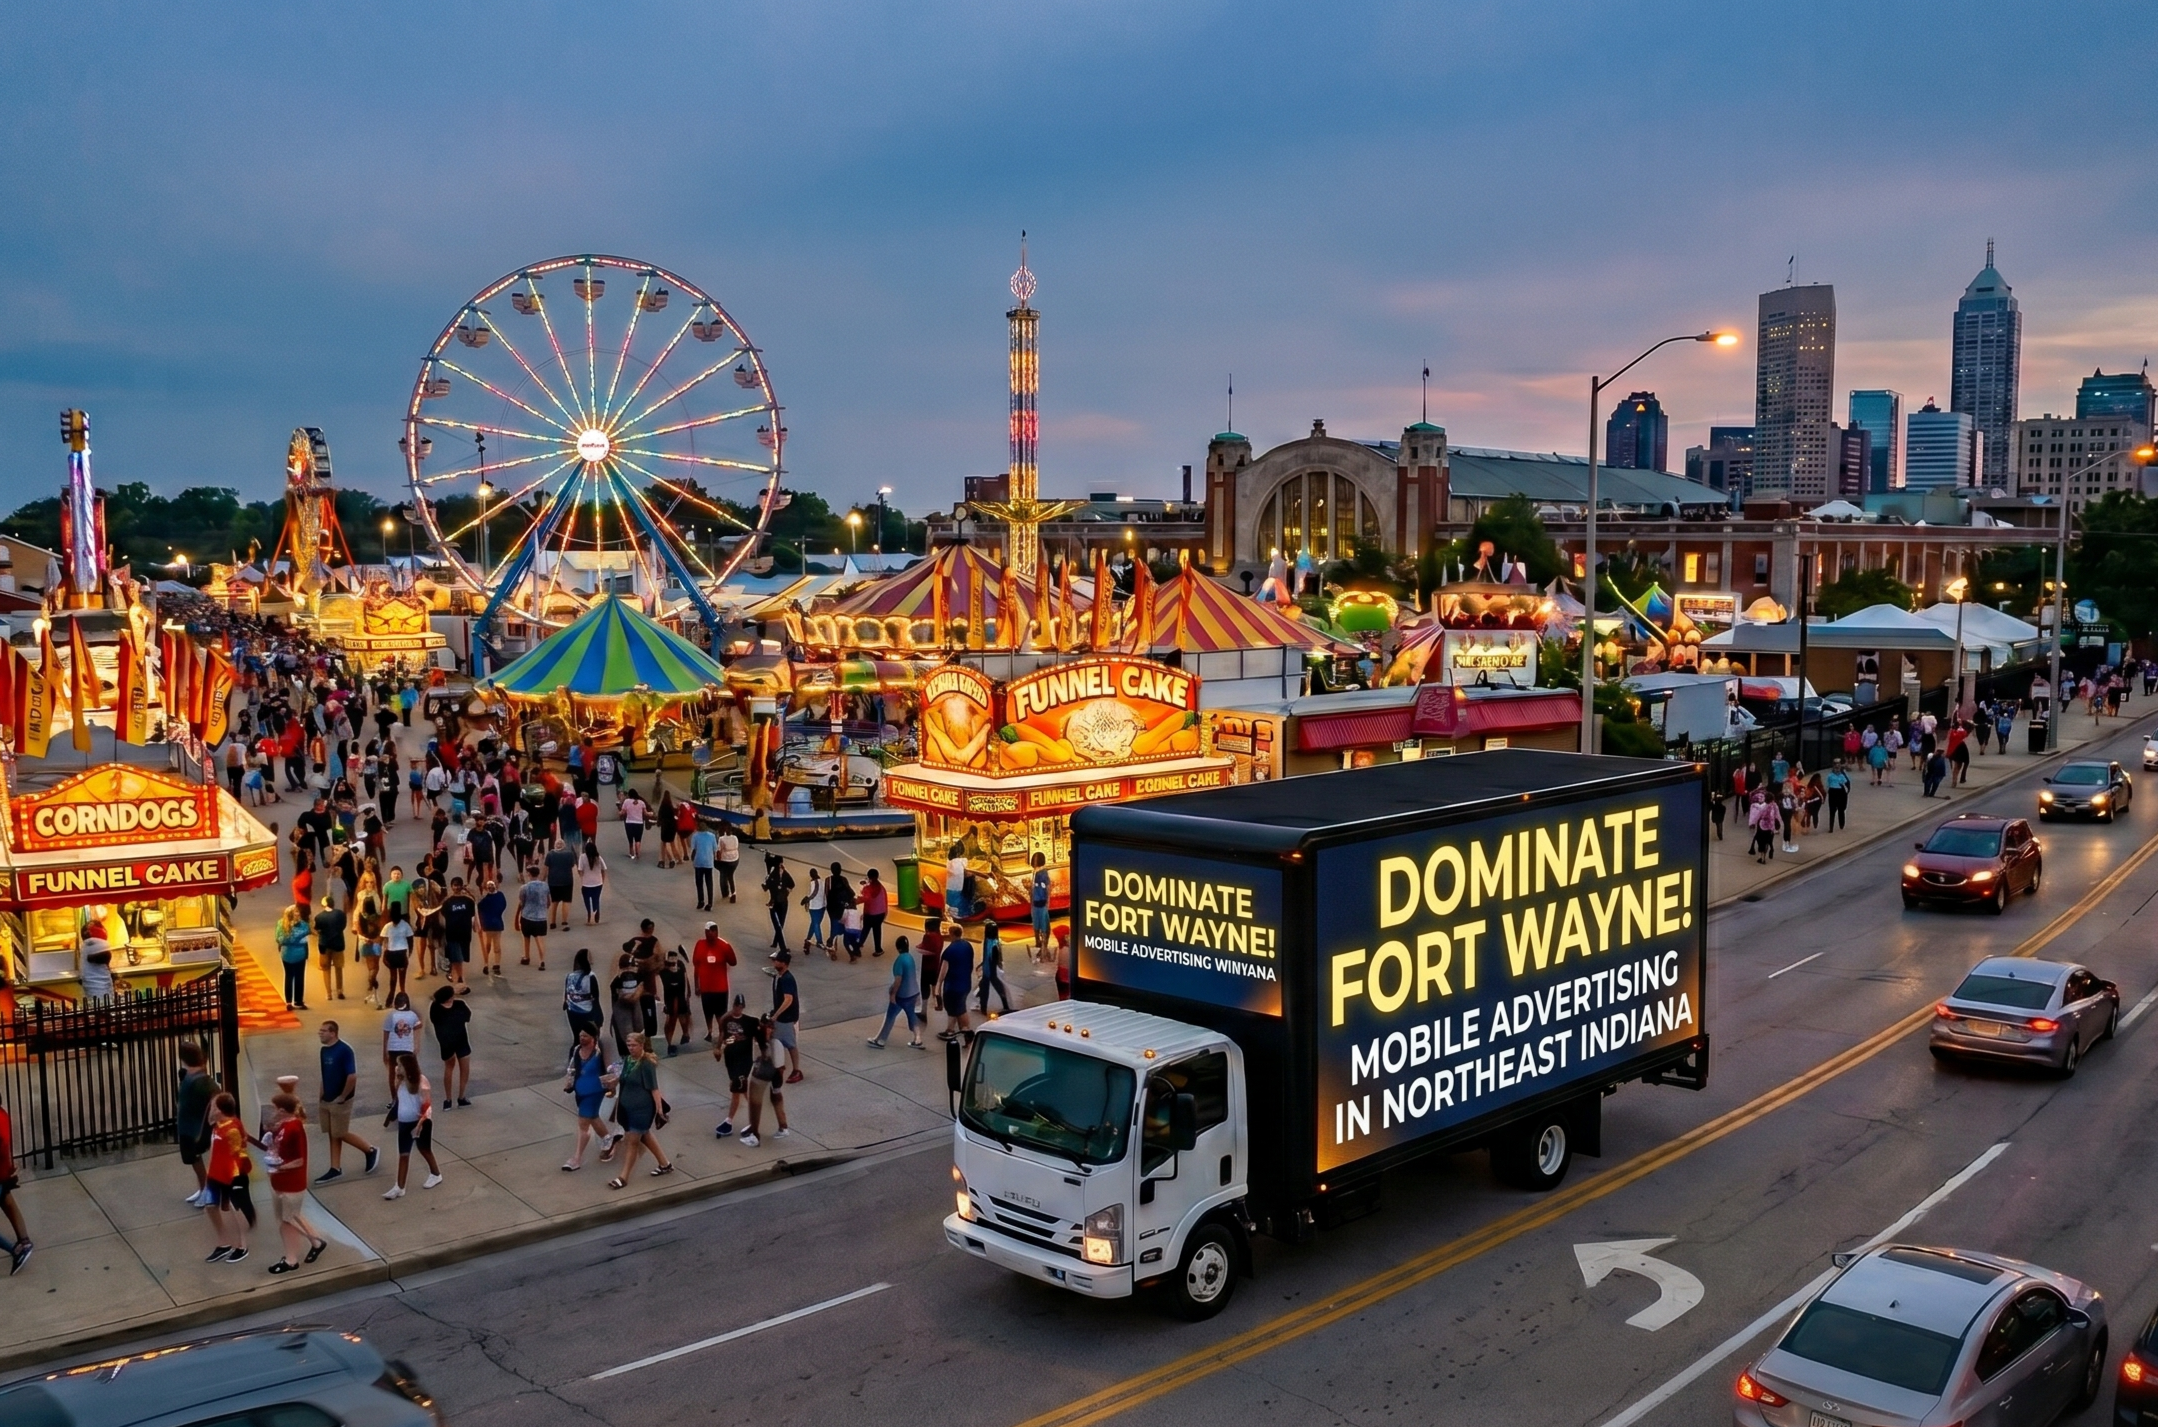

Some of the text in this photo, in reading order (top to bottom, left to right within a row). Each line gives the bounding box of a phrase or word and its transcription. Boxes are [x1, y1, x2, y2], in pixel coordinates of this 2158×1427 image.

[1013, 665, 1116, 721] FUNNEL
[1121, 666, 1189, 708] CAKE
[35, 799, 198, 837] CORNDOGS
[29, 866, 140, 894] FUNNEL
[145, 860, 219, 885] CAKE
[1104, 868, 1253, 919] DOMINATE
[1380, 805, 1659, 929] DOMINATE
[1084, 934, 1277, 982] MOBILE ADVERTISING WINYANA
[1085, 899, 1275, 959] FORT WAYNE!
[1332, 869, 1692, 1027] FORT WAYNE!
[1351, 950, 1678, 1086] MOBILE ADVERTISING
[1336, 992, 1693, 1145] IN NORTHEAST INDIANA
